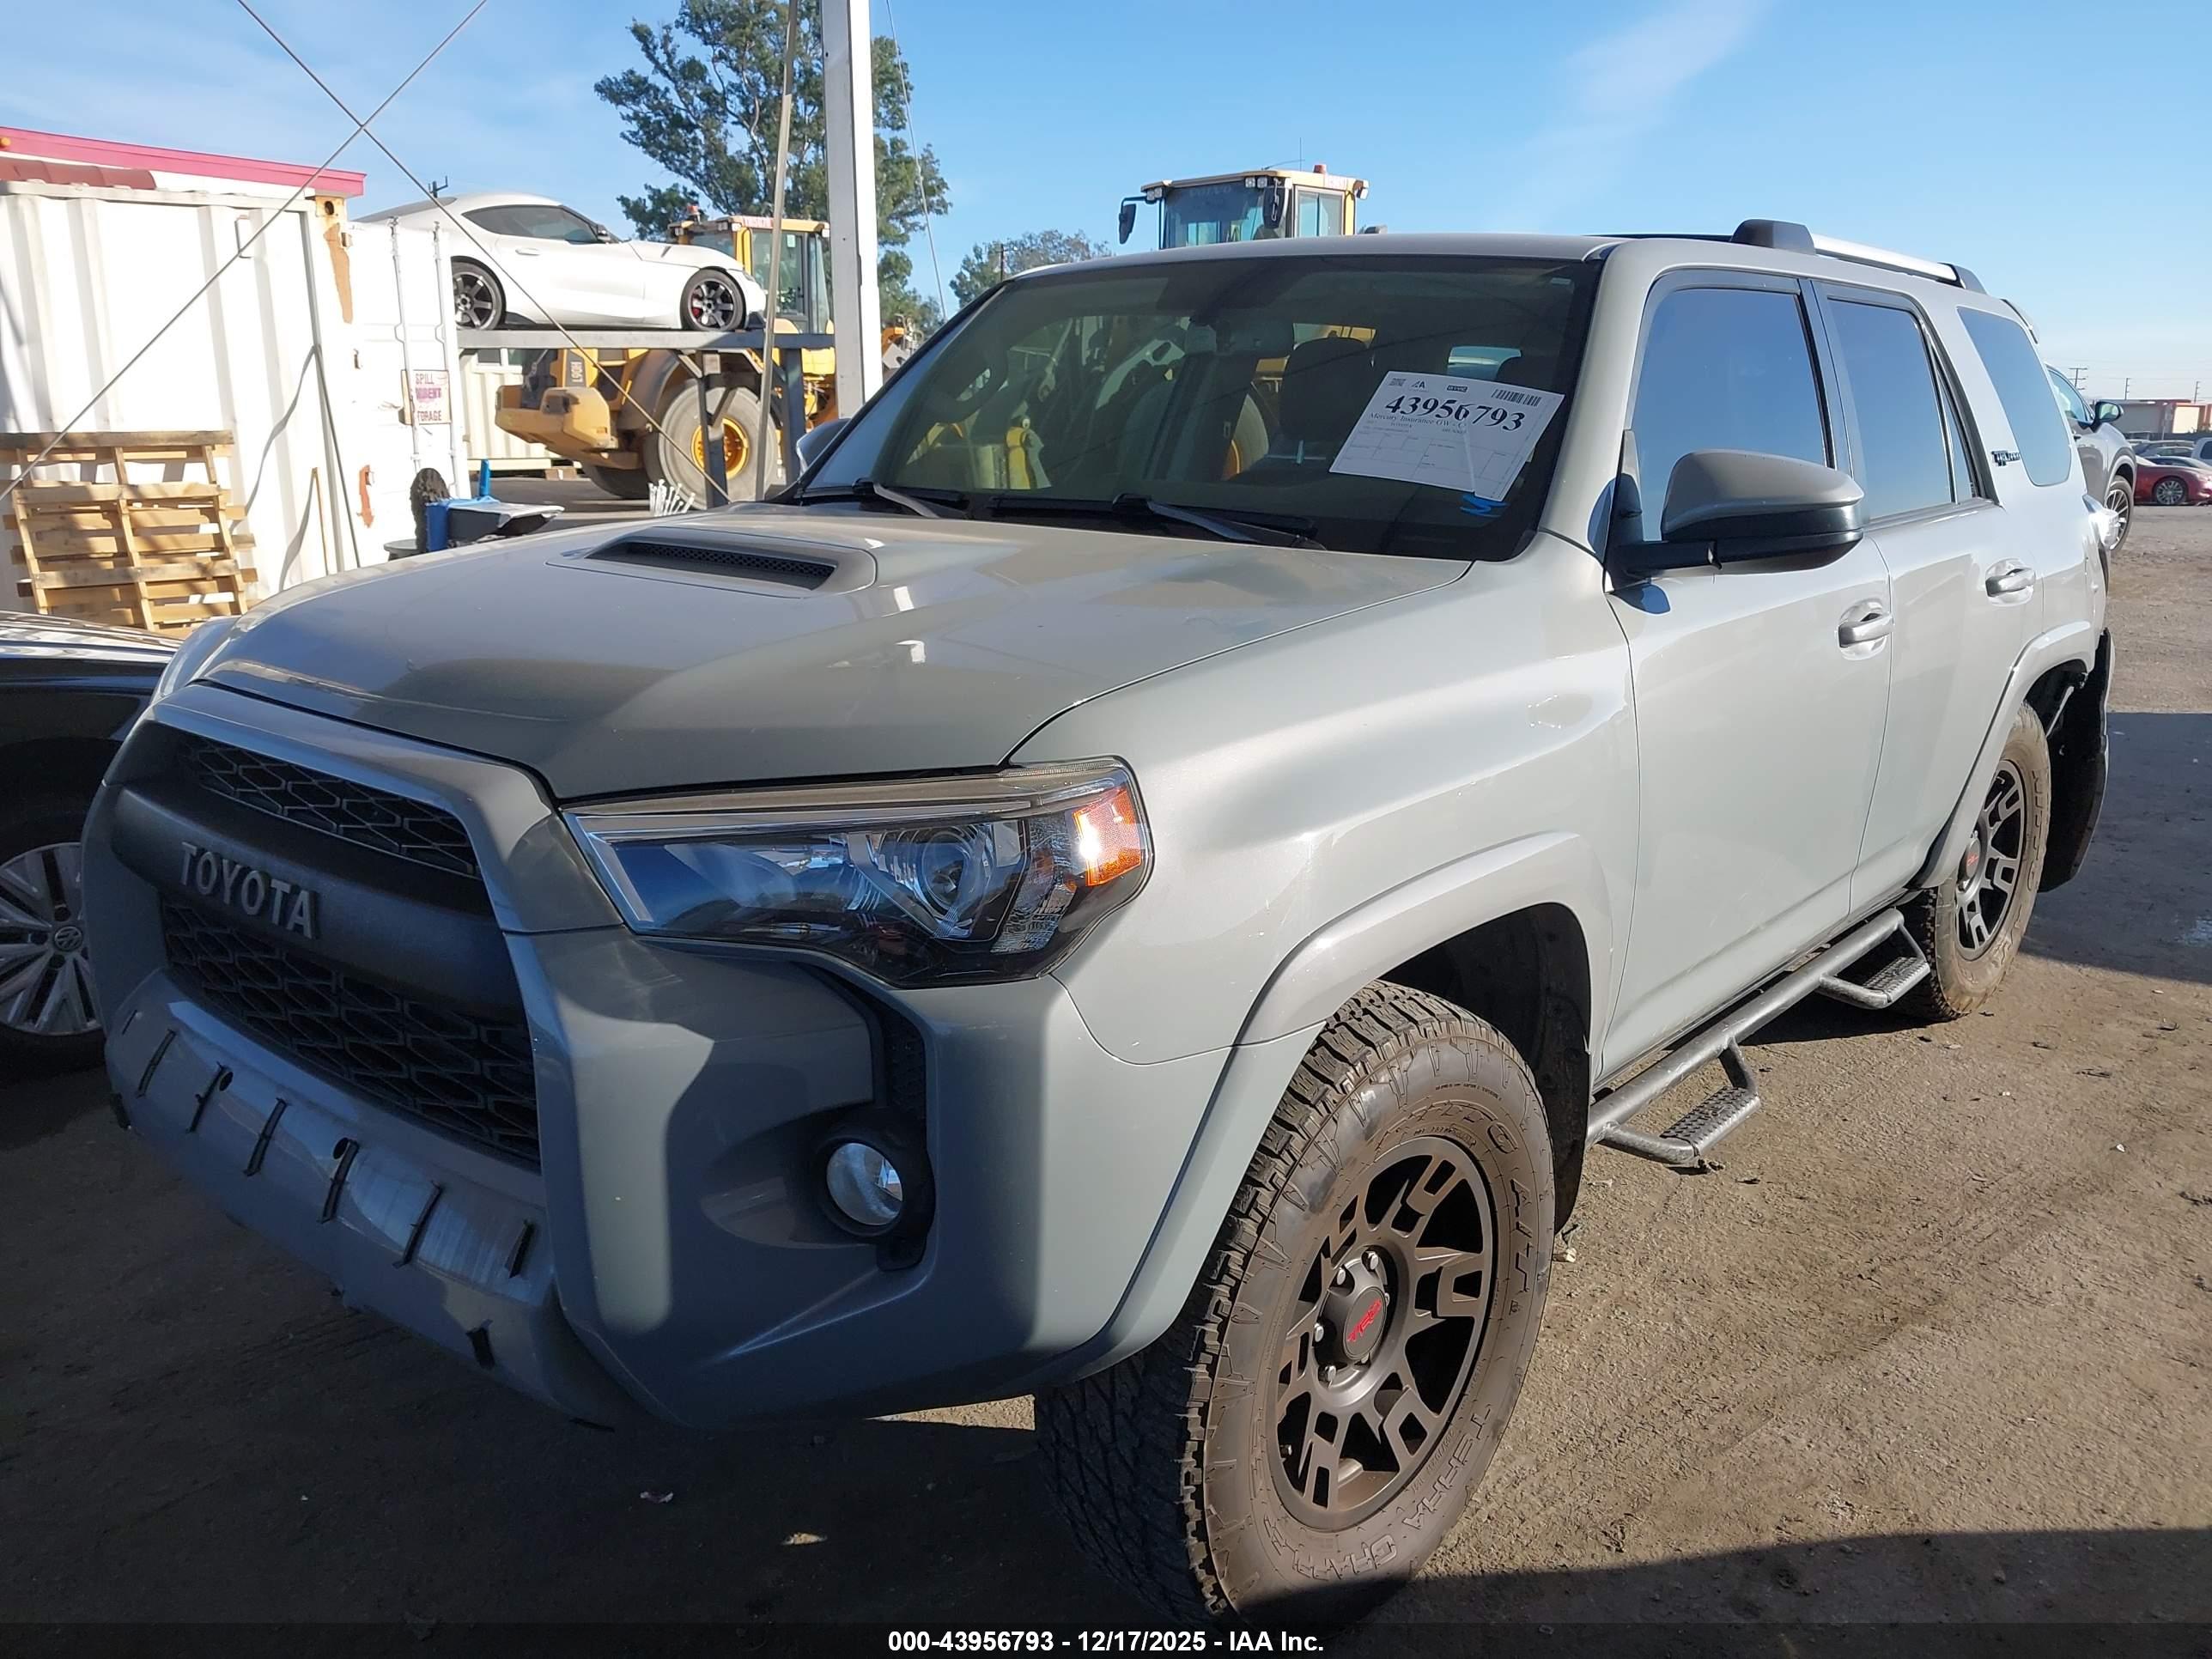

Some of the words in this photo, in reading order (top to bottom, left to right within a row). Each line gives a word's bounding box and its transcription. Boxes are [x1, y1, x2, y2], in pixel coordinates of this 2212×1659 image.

[415, 373, 434, 385] SPILL
[416, 410, 442, 422] TORAGE
[1370, 412, 1397, 422] Mercury
[1401, 415, 1434, 425] Insurance
[1385, 395, 1526, 431] 43956793
[180, 841, 313, 939] TOYOTA
